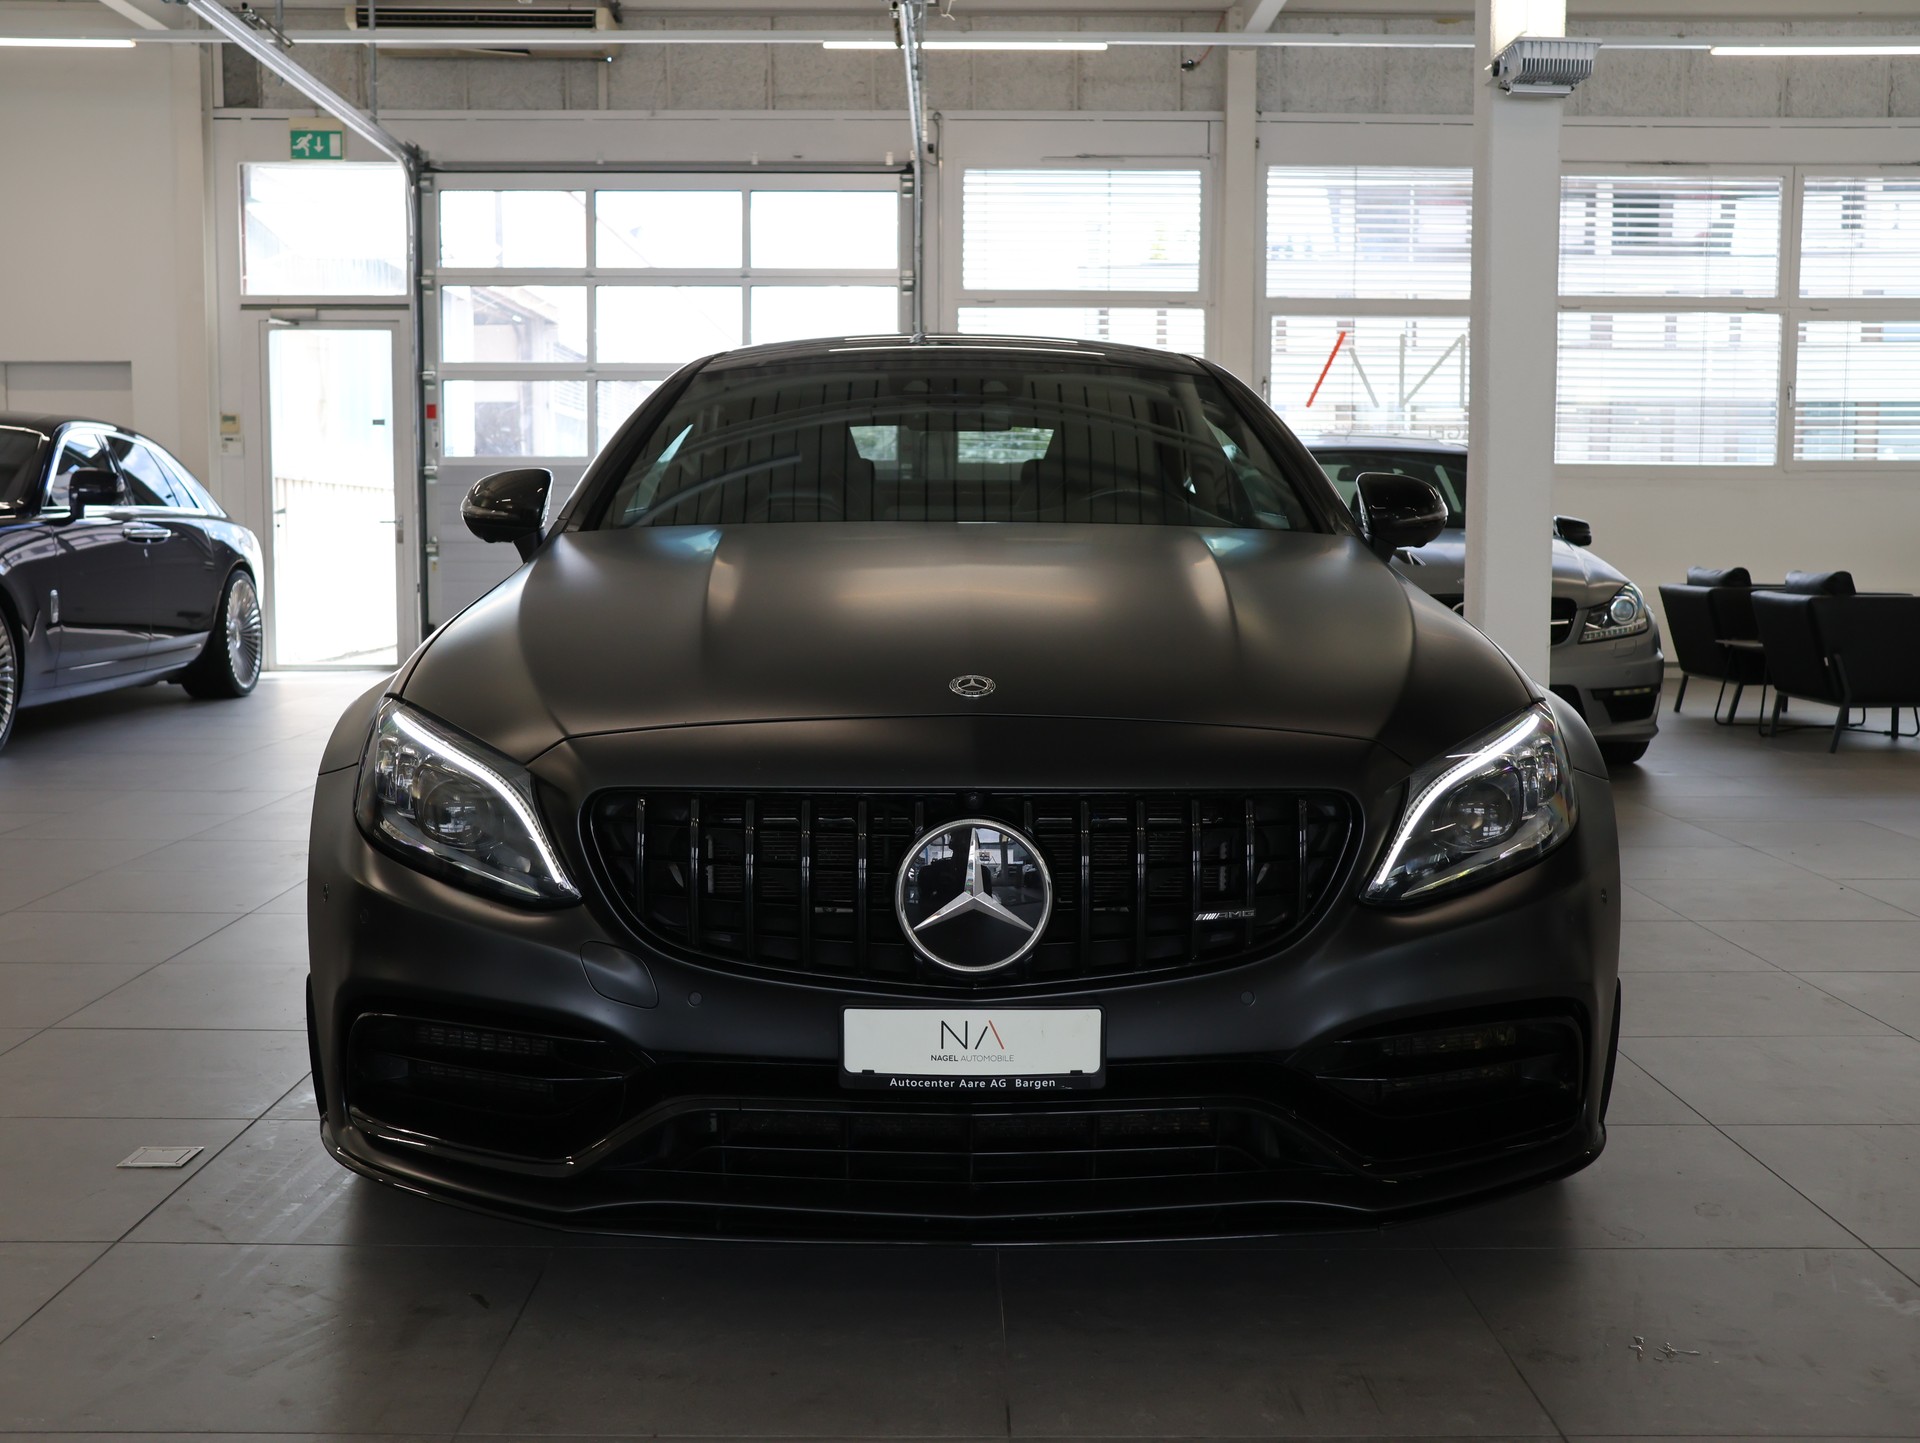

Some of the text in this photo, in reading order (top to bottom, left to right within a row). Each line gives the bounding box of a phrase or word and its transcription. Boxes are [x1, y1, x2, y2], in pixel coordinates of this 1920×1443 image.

[1218, 909, 1255, 919] AMG
[930, 1054, 1015, 1062] NAGEL AUTOMOBILE
[889, 1077, 1056, 1090] Autocenter Aare AG Bargen
